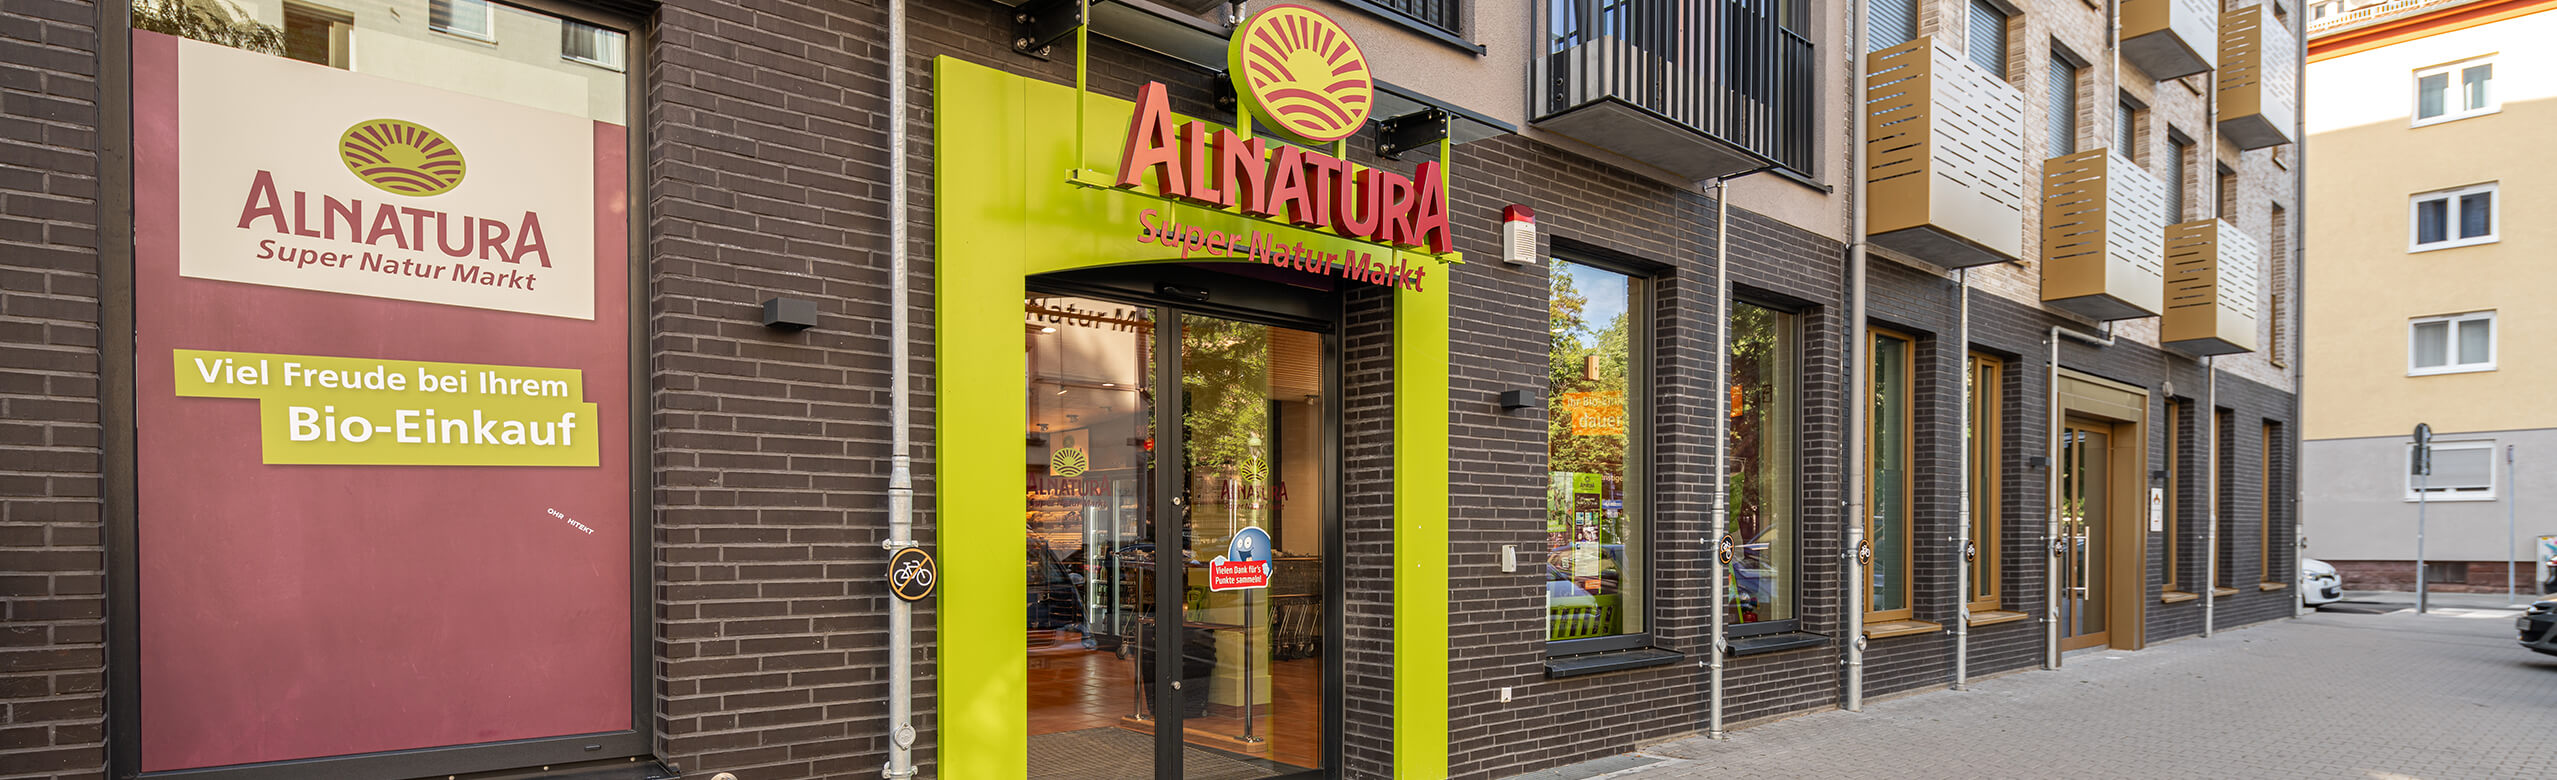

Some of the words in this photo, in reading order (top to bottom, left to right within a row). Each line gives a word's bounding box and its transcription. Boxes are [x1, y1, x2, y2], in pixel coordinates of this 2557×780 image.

[1115, 81, 1452, 253] ALNATURA
[236, 169, 553, 269] ALNATURA
[255, 238, 353, 269] Super
[359, 250, 446, 281] Natur
[451, 264, 537, 292] Markt
[1138, 207, 1241, 260] Super
[1248, 230, 1337, 278] Natur
[1343, 248, 1425, 293] Markt
[194, 357, 269, 386] Viel
[282, 362, 407, 391] Freude
[417, 367, 469, 394] bei
[478, 371, 569, 397] Ihrem
[288, 406, 576, 446] Bio-Einkauf
[1026, 471, 1112, 497] ALNATURA
[547, 508, 564, 519] OHR
[567, 518, 594, 534] HITEKT
[1215, 576, 1235, 585] Punkte
[1236, 574, 1262, 584] sammeln!
[1216, 565, 1234, 575] Vielen
[1234, 564, 1248, 574] Dank
